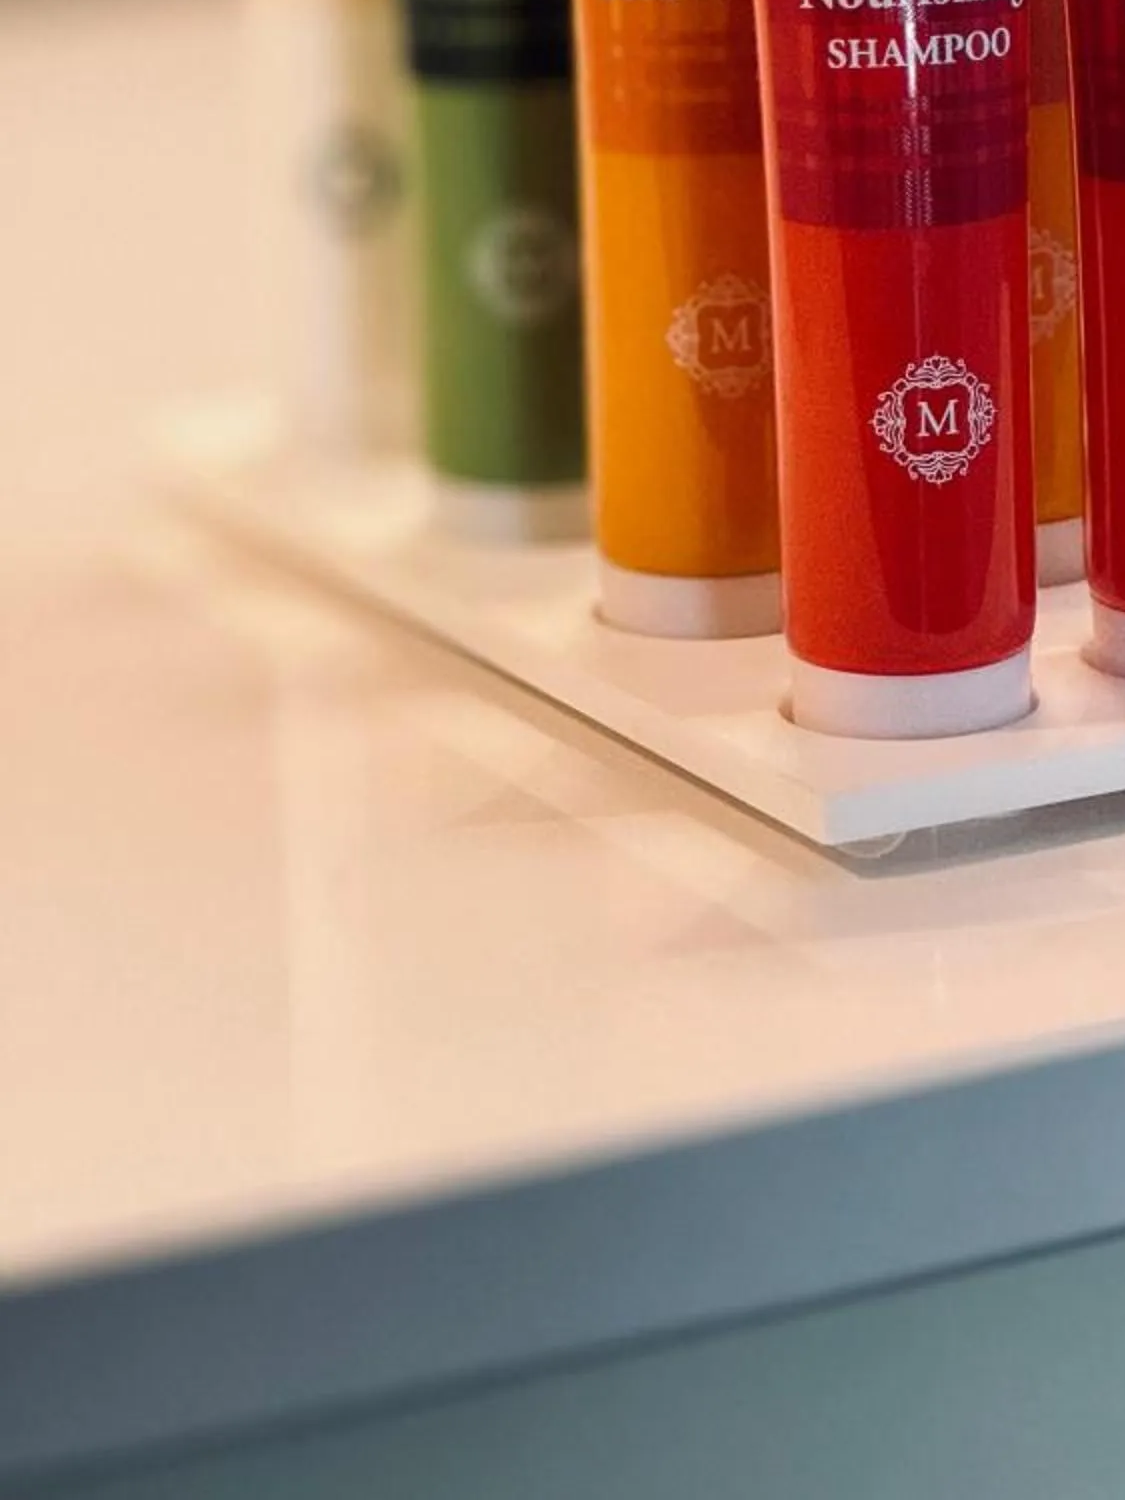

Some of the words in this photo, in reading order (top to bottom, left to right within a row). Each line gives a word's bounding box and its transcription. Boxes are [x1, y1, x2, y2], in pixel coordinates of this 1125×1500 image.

[826, 26, 1011, 71] SHAMPOO
[711, 316, 752, 355] M
[916, 399, 961, 437] M
